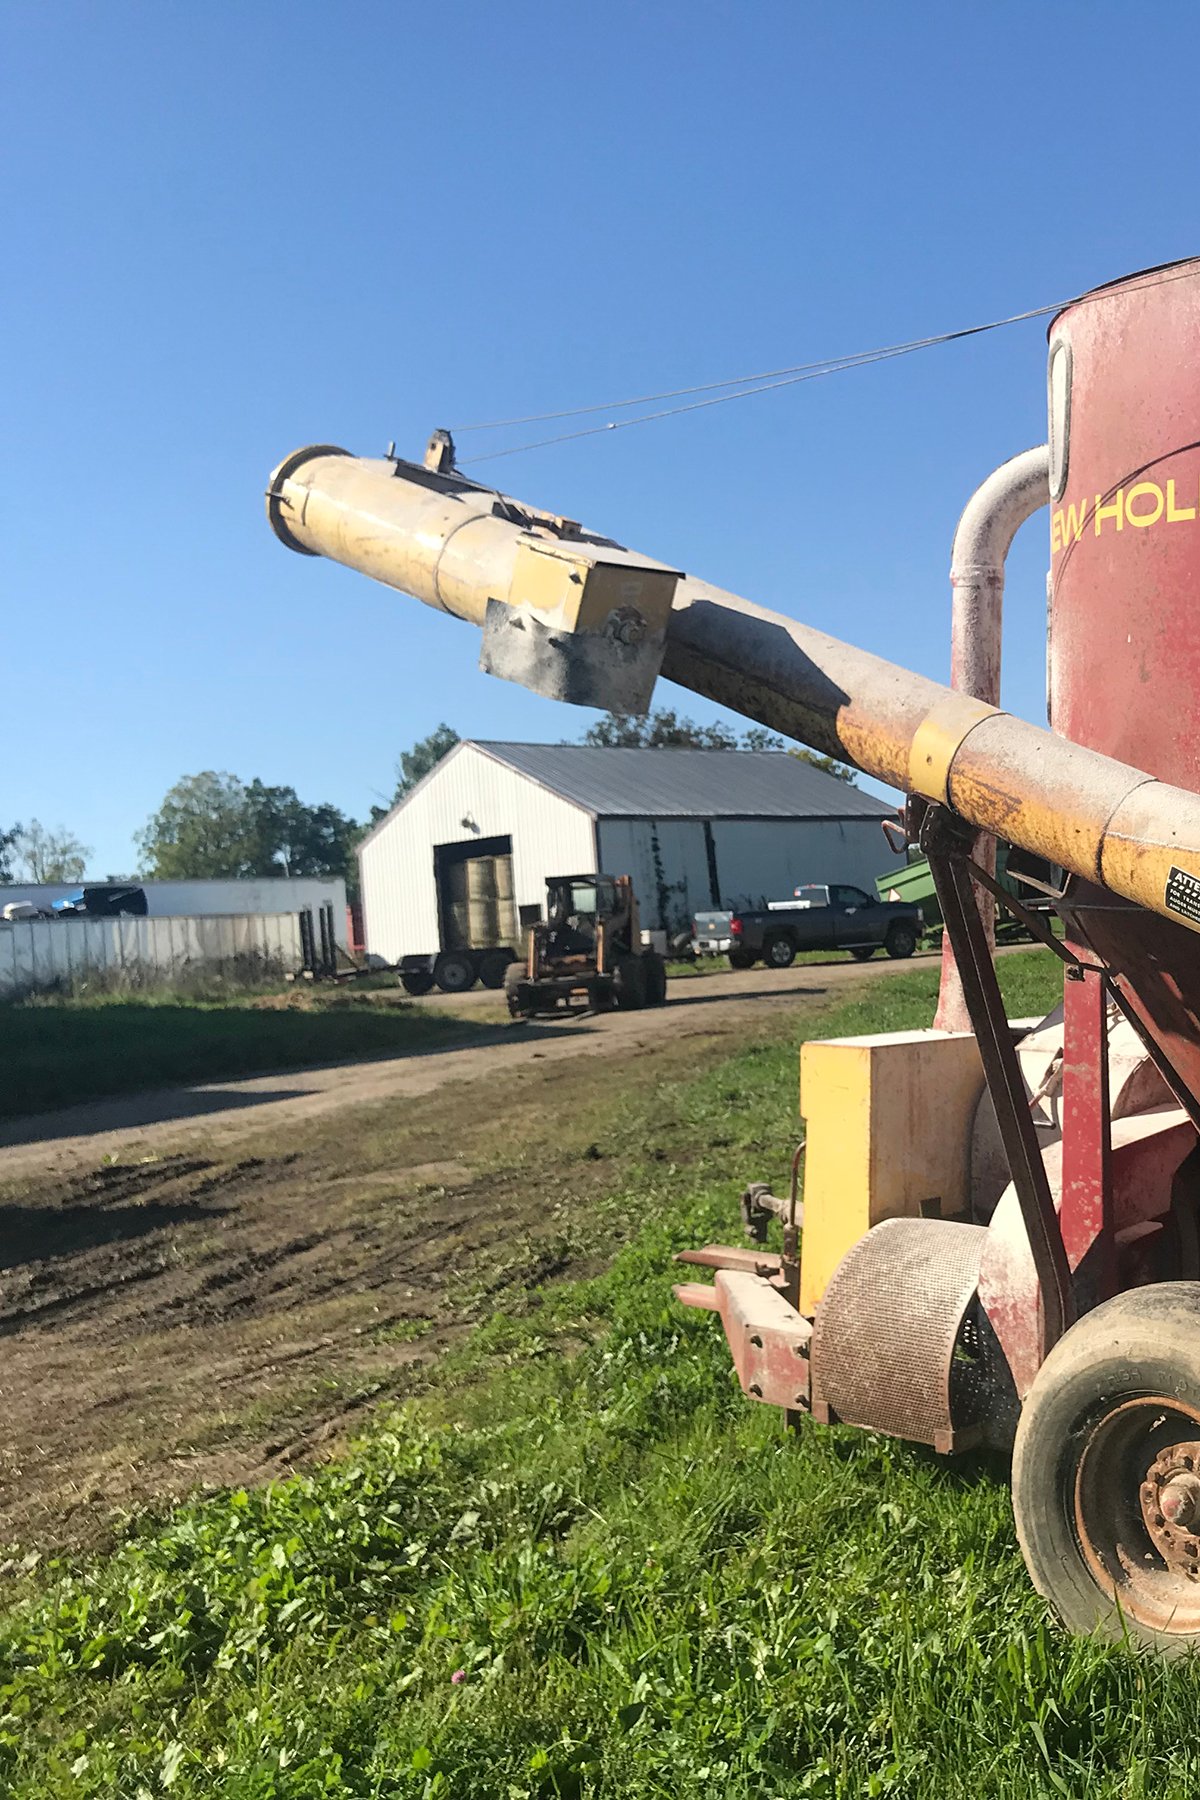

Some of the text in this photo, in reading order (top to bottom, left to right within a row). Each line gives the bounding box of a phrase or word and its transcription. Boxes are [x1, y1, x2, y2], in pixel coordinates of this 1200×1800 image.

[1051, 499, 1087, 554] EW
[1170, 897, 1186, 908] AUGER
[1188, 906, 1200, 915] MUST
